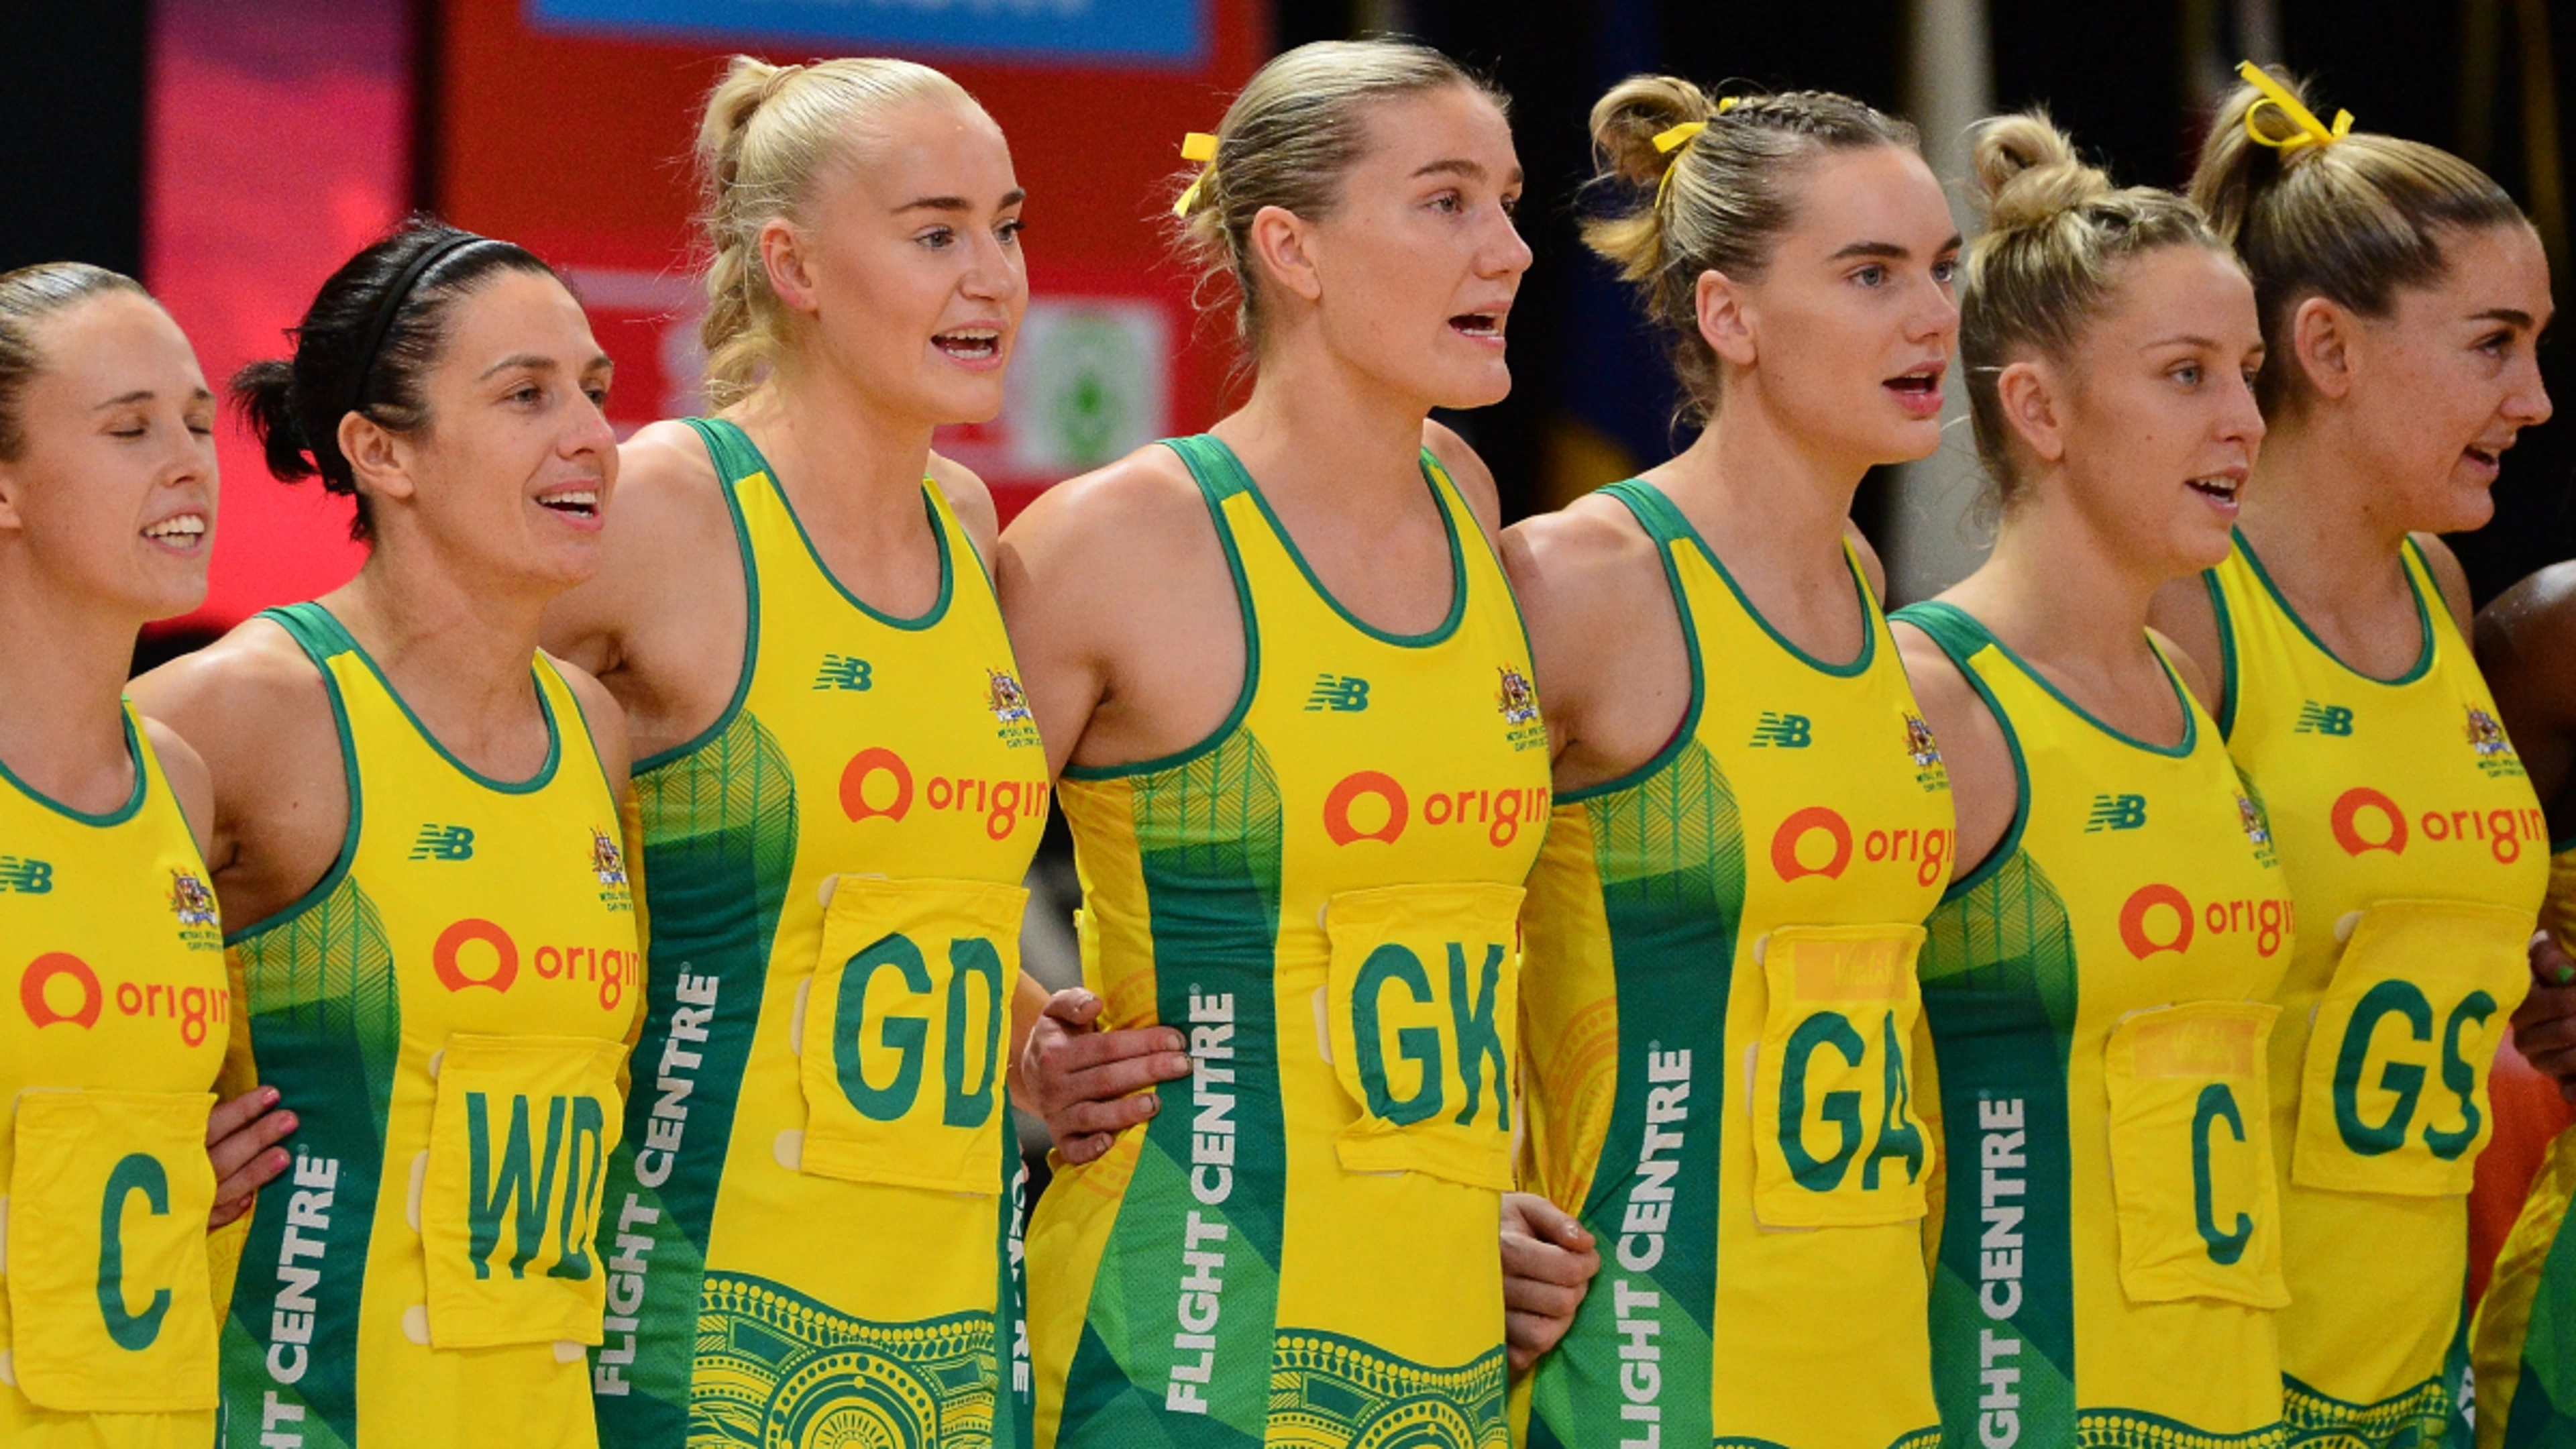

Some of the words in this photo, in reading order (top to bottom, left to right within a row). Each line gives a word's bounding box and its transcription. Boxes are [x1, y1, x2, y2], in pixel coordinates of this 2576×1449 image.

[812, 654, 872, 692] NB
[1303, 674, 1370, 712] NB
[1749, 711, 1811, 748] NB
[2294, 700, 2353, 737] NB
[408, 823, 474, 861] NB
[927, 777, 1047, 841] origin
[1424, 788, 1546, 847] origin
[1865, 828, 1954, 887] origi
[2084, 794, 2146, 833] NB
[2422, 809, 2547, 865] origin
[2206, 899, 2295, 958] origi
[833, 933, 1004, 1128] GD
[1189, 990, 1235, 1204] CENTRE
[1352, 943, 1509, 1131] GK
[1778, 1010, 1923, 1192] GA
[2332, 979, 2496, 1161] GS
[97, 1154, 171, 1350] C
[466, 1093, 603, 1279] WD
[596, 1193, 659, 1395] FLIGHT
[636, 974, 718, 1187] CENTRE
[1617, 1050, 1690, 1272] CENTRE
[1980, 1099, 2025, 1320] CENTRE
[2192, 1083, 2253, 1265] C
[266, 1155, 338, 1384] CENTRE
[1166, 1211, 1228, 1414] FLIGHT
[1614, 1279, 1661, 1449] LIGHT
